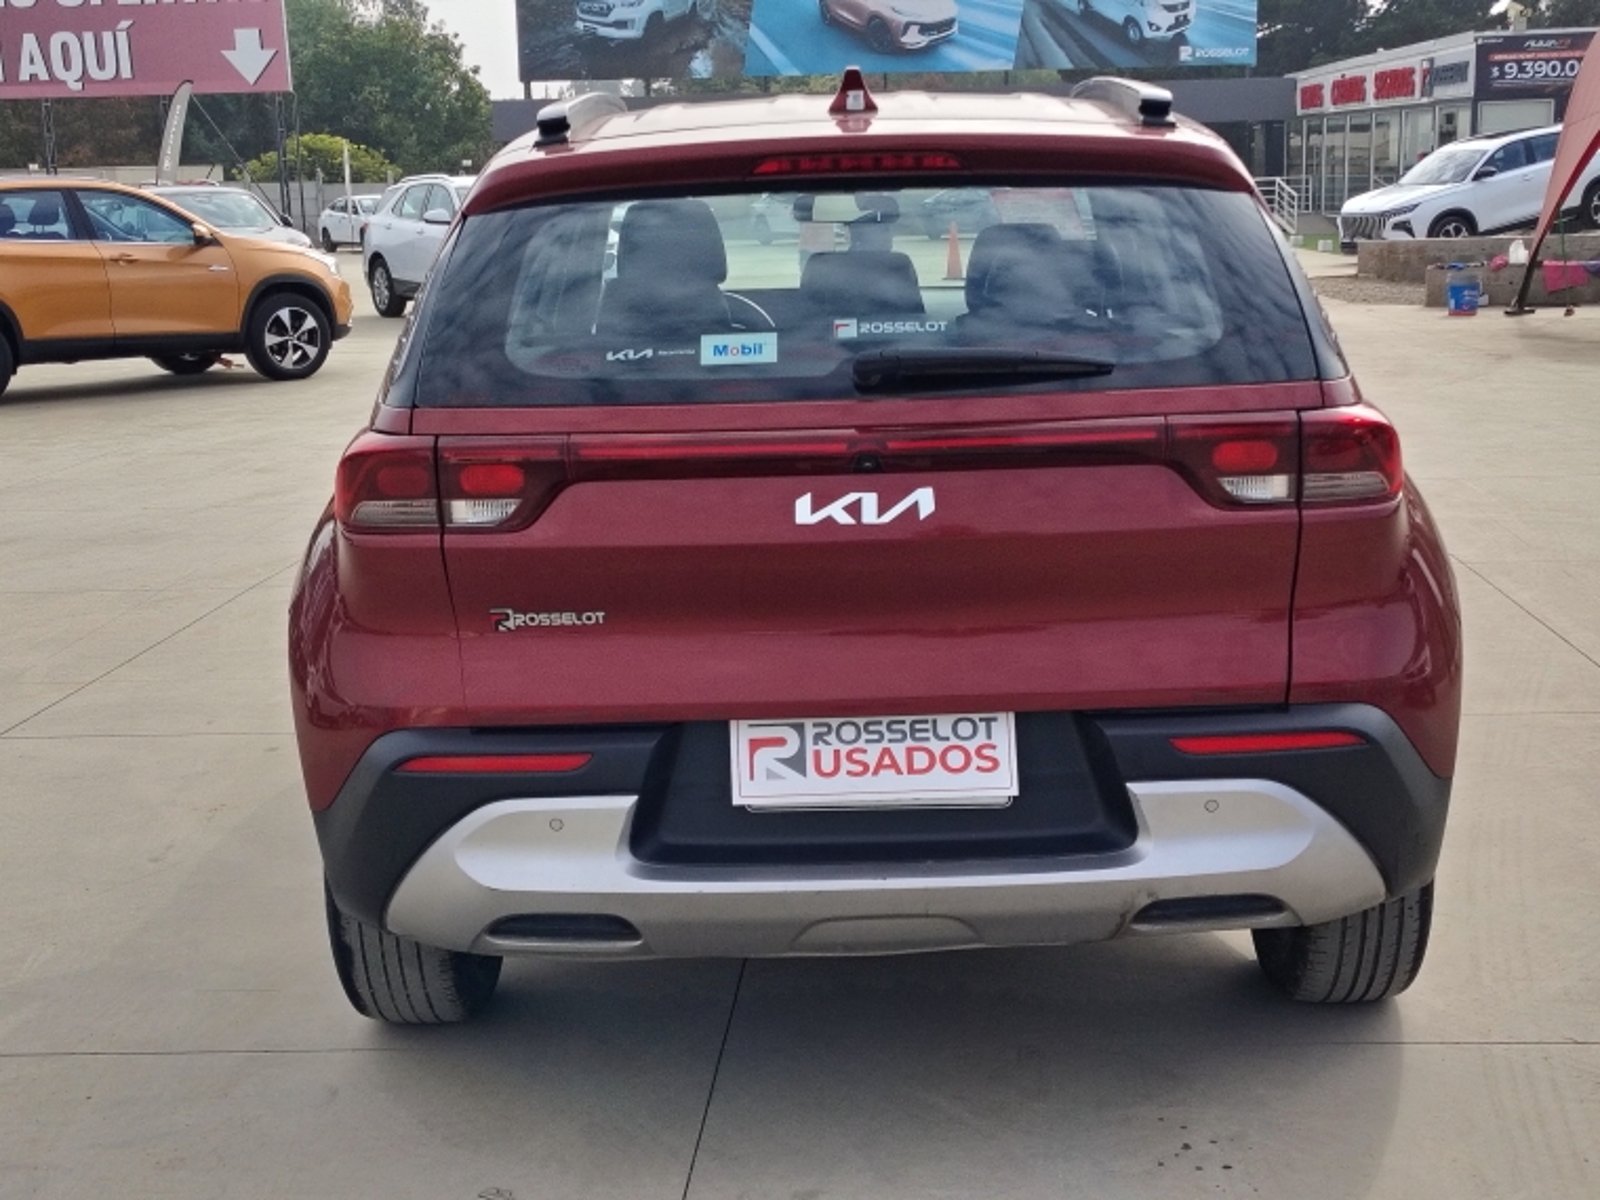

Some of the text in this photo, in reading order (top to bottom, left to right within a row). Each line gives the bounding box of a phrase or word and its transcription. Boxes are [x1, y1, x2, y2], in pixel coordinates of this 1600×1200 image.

[19, 20, 135, 91] AQUÍ
[859, 320, 948, 333] ROSSELOT
[606, 348, 654, 361] KIA
[713, 343, 763, 357] Mobil
[795, 486, 936, 525] KIA
[513, 611, 606, 627] ROSSELOT
[812, 716, 998, 746] ROSSELOT
[812, 743, 1001, 778] USADOS
